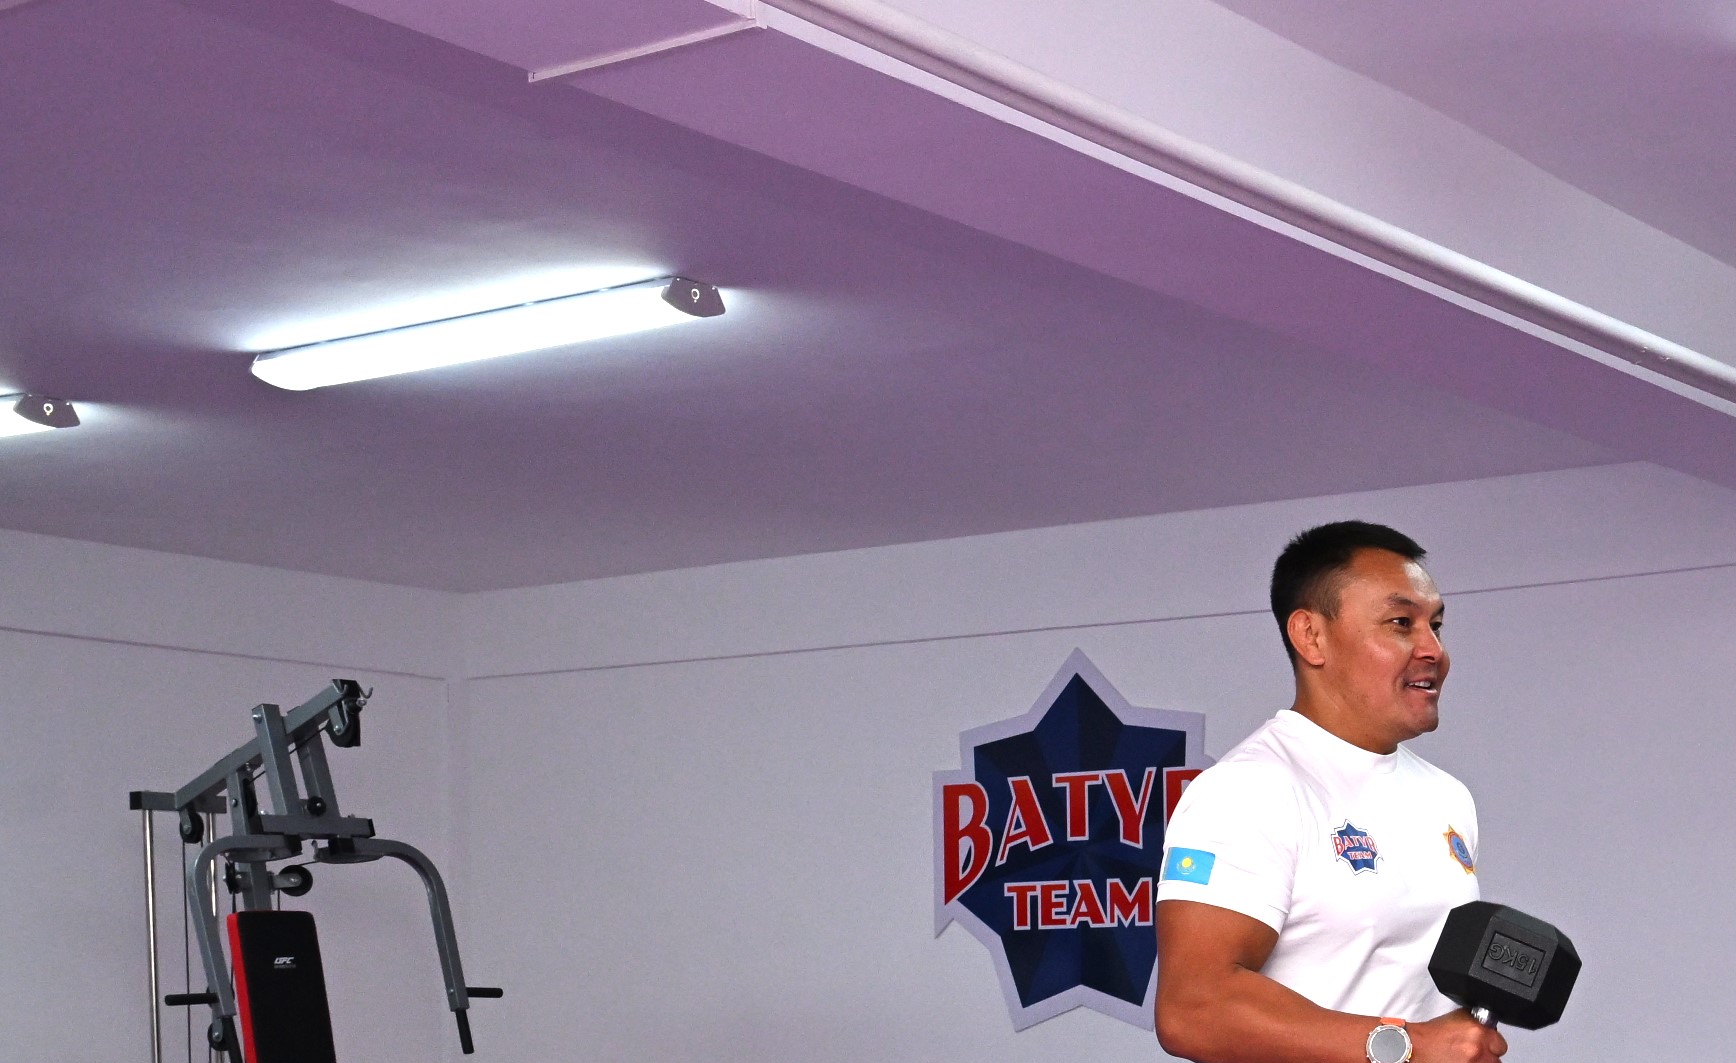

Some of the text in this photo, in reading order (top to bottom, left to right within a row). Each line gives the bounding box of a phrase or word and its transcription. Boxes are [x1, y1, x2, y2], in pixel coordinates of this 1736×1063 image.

[1332, 835, 1378, 856] BATYR
[1003, 877, 1154, 931] TEAM
[1487, 942, 1537, 976] 15KG
